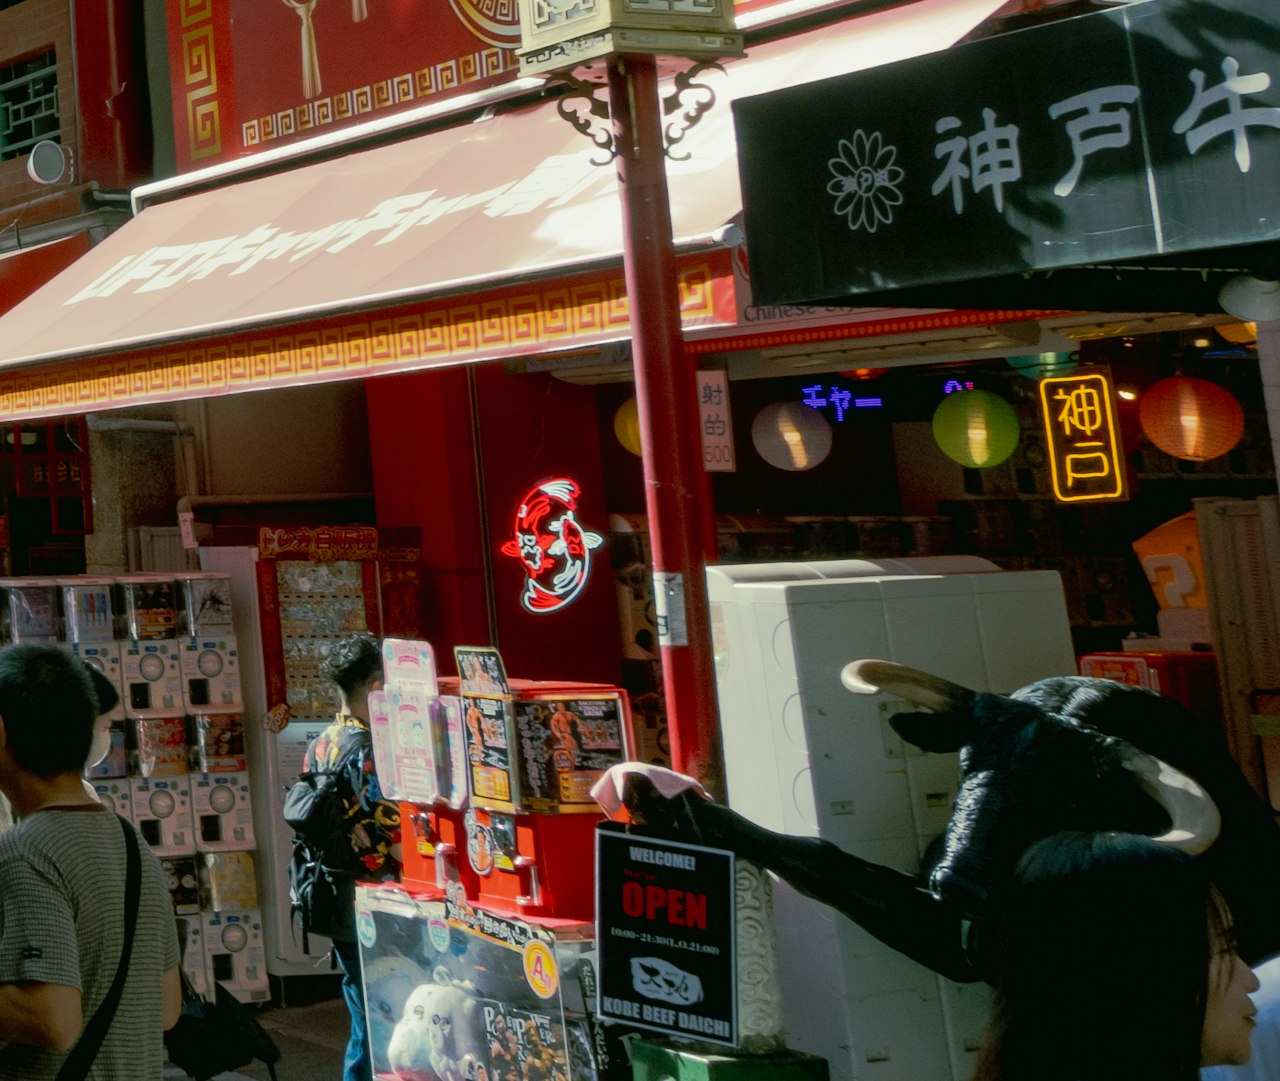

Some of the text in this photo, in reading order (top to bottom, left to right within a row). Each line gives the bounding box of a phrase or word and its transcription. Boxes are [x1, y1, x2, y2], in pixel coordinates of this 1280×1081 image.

[932, 56, 1280, 214] 神戸牛
[702, 382, 729, 437] 射的
[703, 445, 732, 465] 500
[1052, 384, 1110, 489] 神戸
[629, 846, 696, 871] WELCOME!
[622, 881, 708, 930] OPEN
[602, 996, 731, 1037] KOBE BEEF DAICHI
